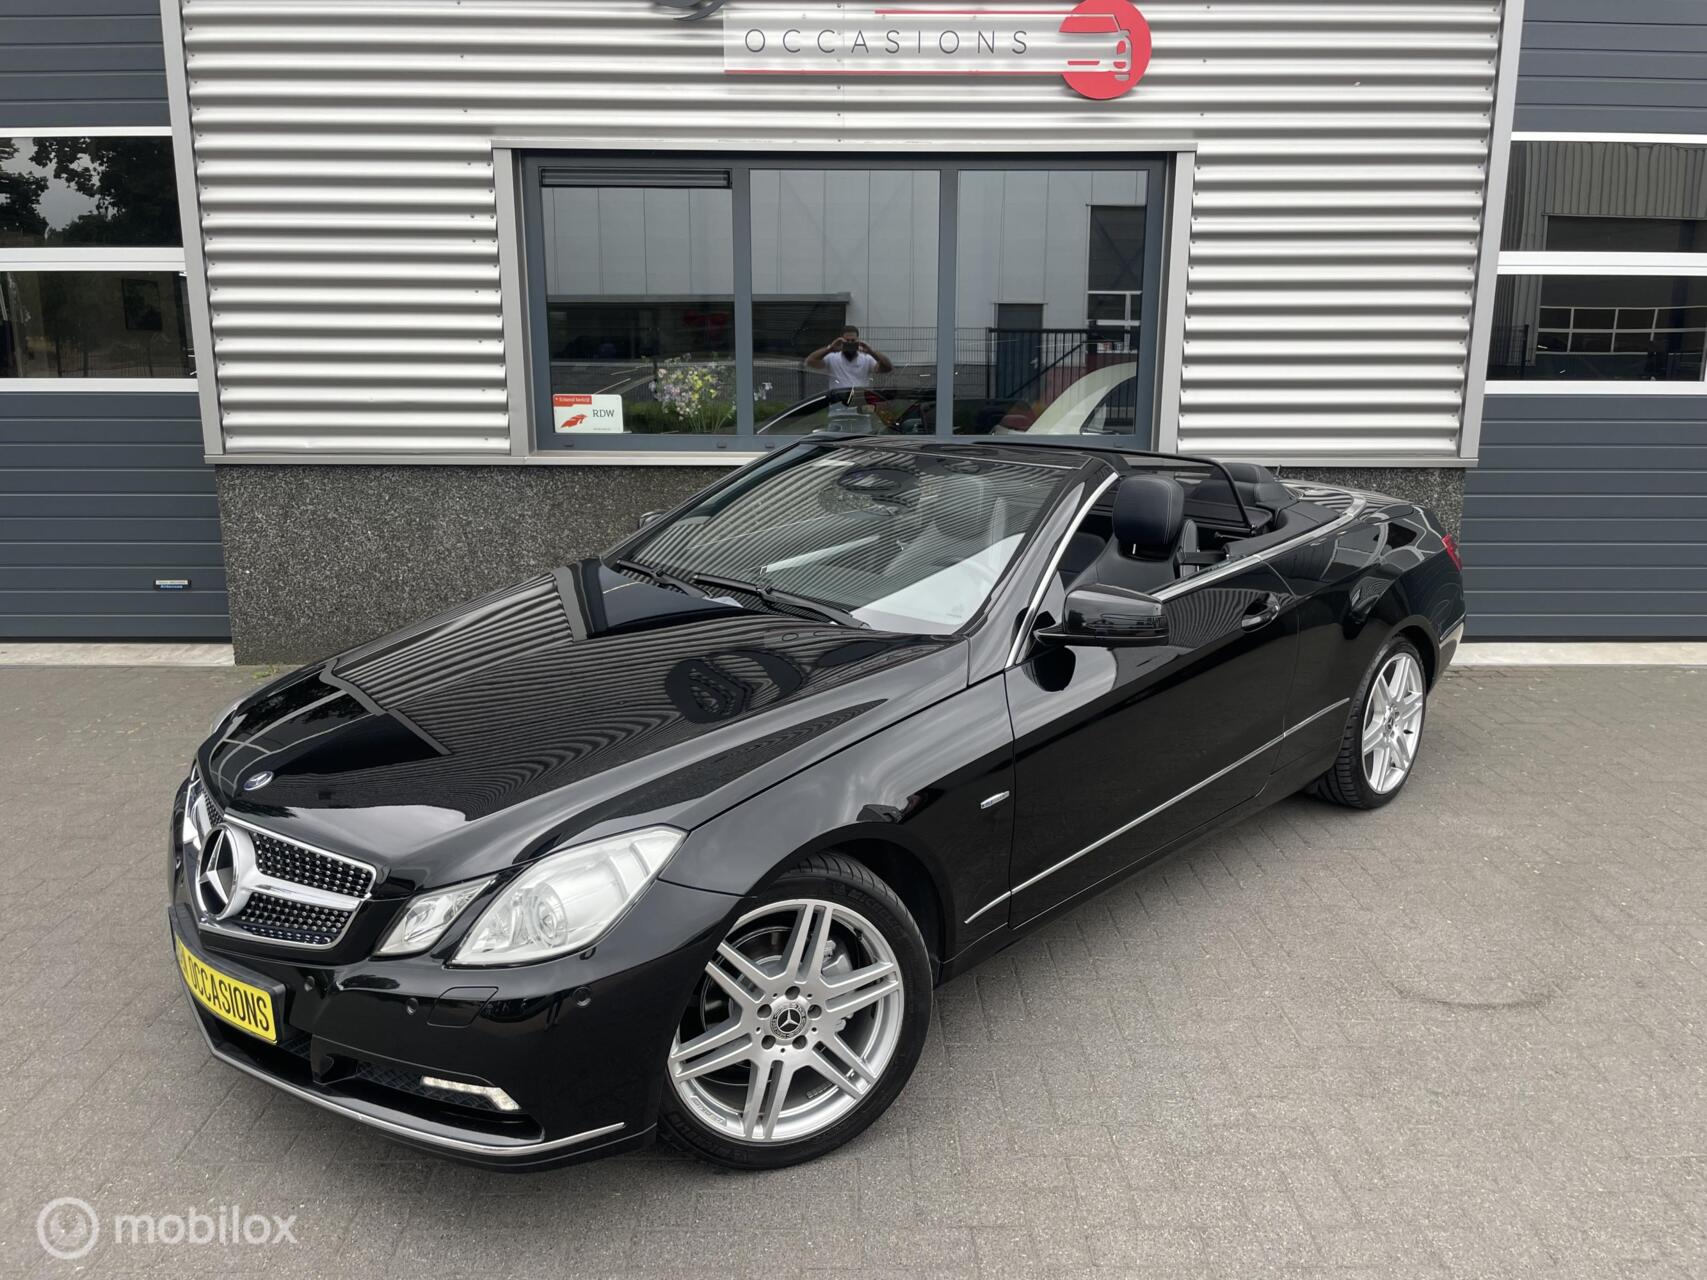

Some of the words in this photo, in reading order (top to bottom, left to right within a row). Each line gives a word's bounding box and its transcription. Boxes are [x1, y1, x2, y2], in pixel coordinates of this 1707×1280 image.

[744, 28, 1028, 55] OCCASIONS
[592, 409, 615, 418] RDW
[188, 954, 270, 1032] OCCASIONS
